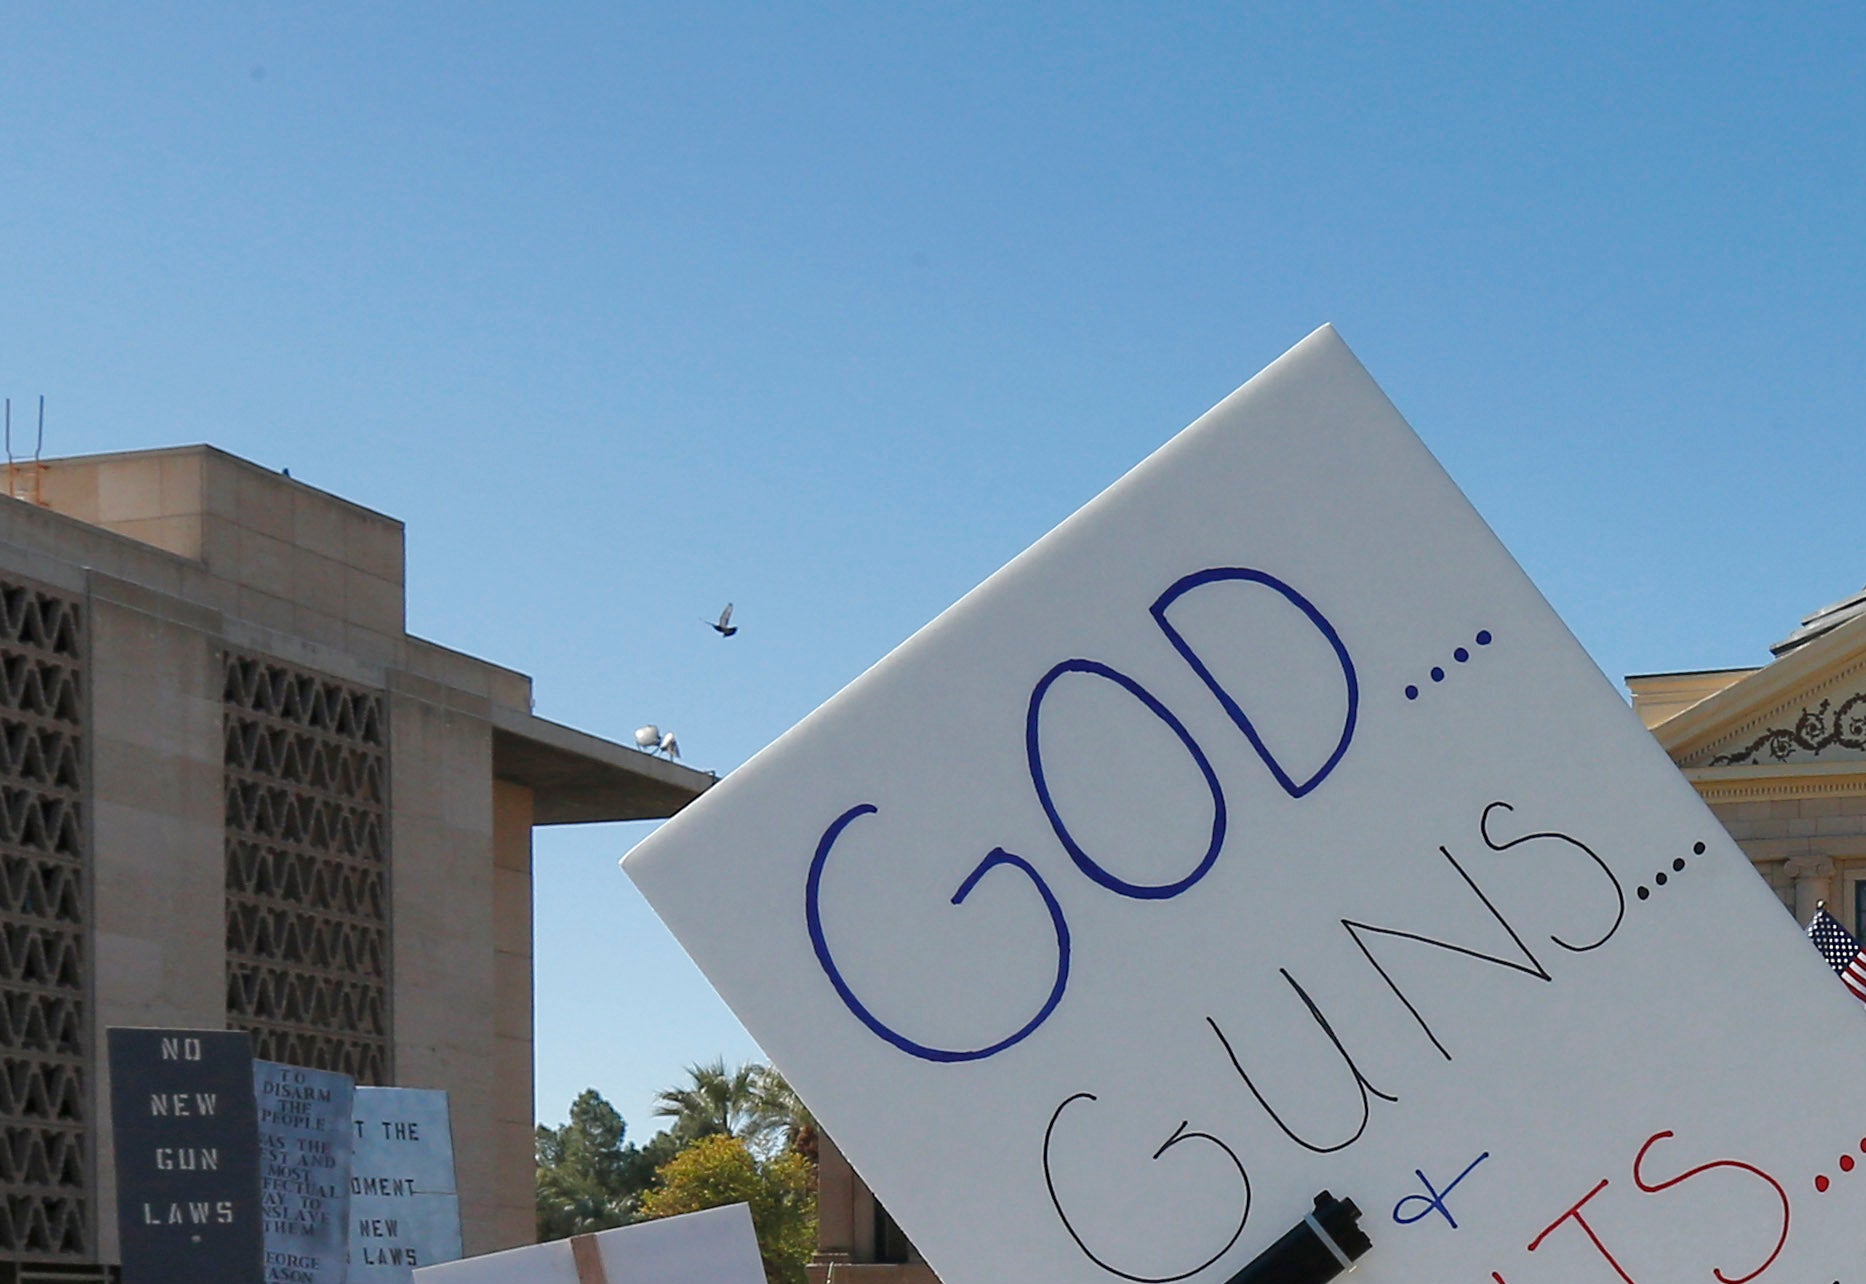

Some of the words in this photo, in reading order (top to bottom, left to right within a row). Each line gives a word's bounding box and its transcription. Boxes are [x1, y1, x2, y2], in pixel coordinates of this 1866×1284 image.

[161, 1037, 201, 1061] NO
[281, 1068, 306, 1085] TO
[263, 1080, 331, 1103] DISARM
[151, 1093, 217, 1117] NEW
[278, 1098, 313, 1116] THE
[261, 1108, 326, 1131] PEOPLE
[381, 1120, 420, 1142] THE
[261, 1134, 286, 1150] AS
[156, 1147, 219, 1171] GUN
[297, 1153, 337, 1169] AND
[268, 1163, 311, 1183] MOST
[351, 1176, 416, 1197] DMENT
[261, 1190, 286, 1206] AY
[143, 1201, 233, 1225] LAWS
[262, 1205, 328, 1224] NSLAVE
[359, 1218, 399, 1238] NEW
[265, 1250, 320, 1270] EORGE
[362, 1246, 418, 1267] LAWS
[269, 1266, 314, 1284] ASON
